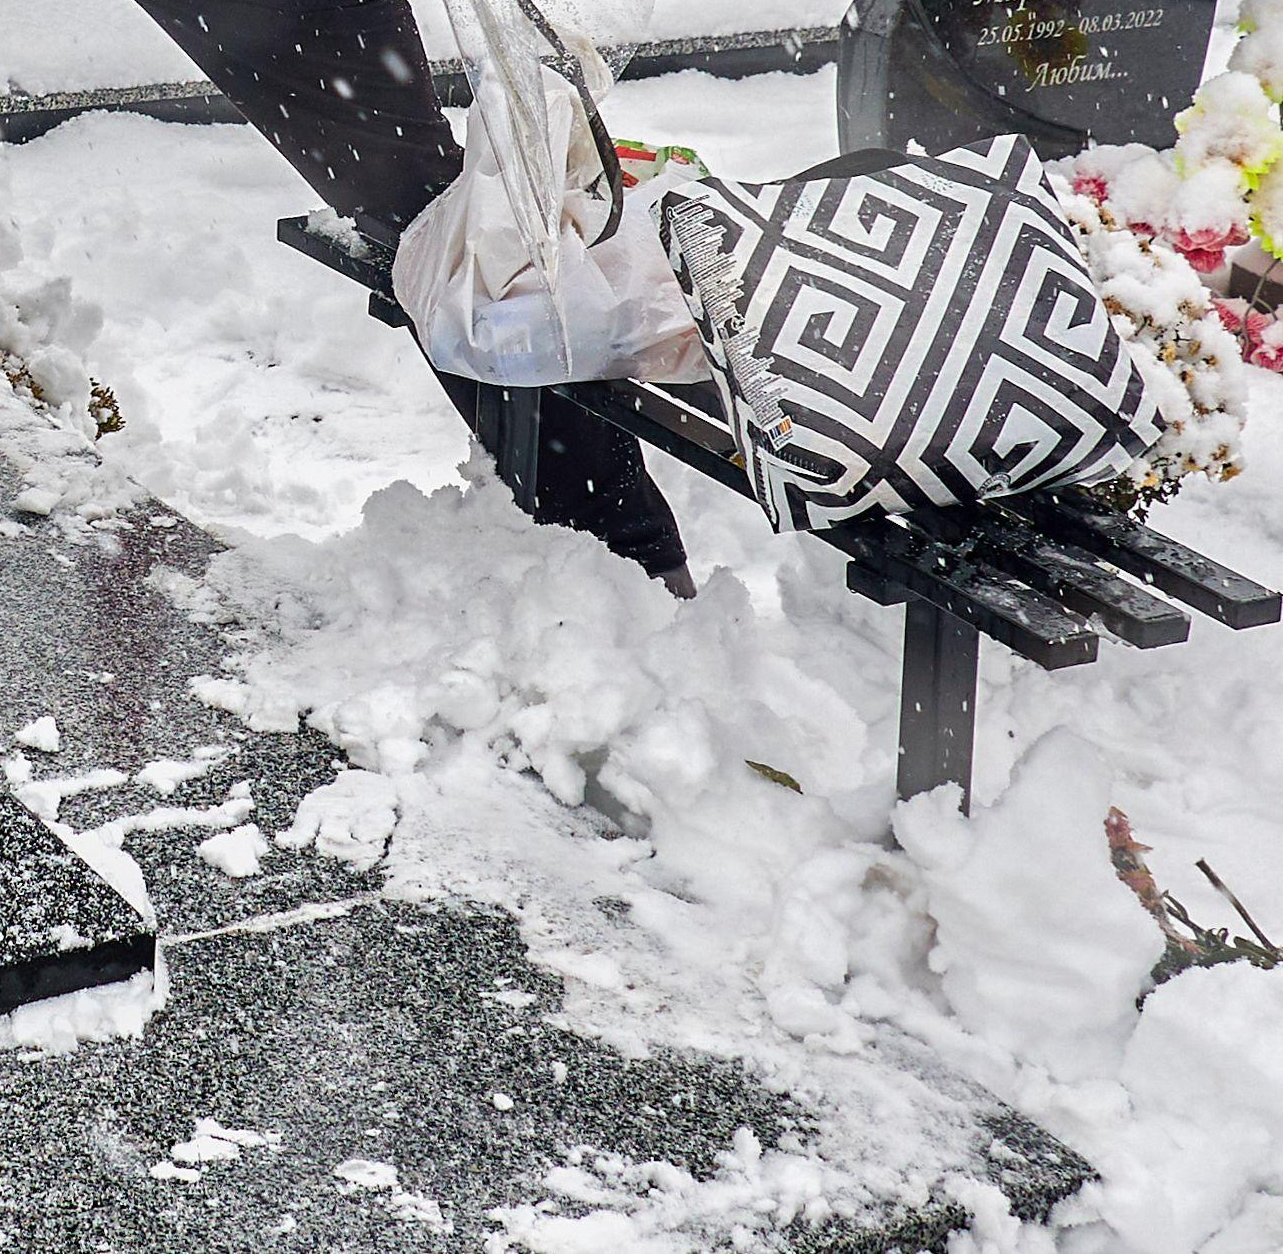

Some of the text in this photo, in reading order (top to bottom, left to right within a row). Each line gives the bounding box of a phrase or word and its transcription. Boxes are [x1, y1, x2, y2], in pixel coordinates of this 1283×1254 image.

[977, 17, 1065, 47] 25.05.1992
[1079, 9, 1164, 41] 08.03.2022
[1025, 53, 1129, 93] Любим...
